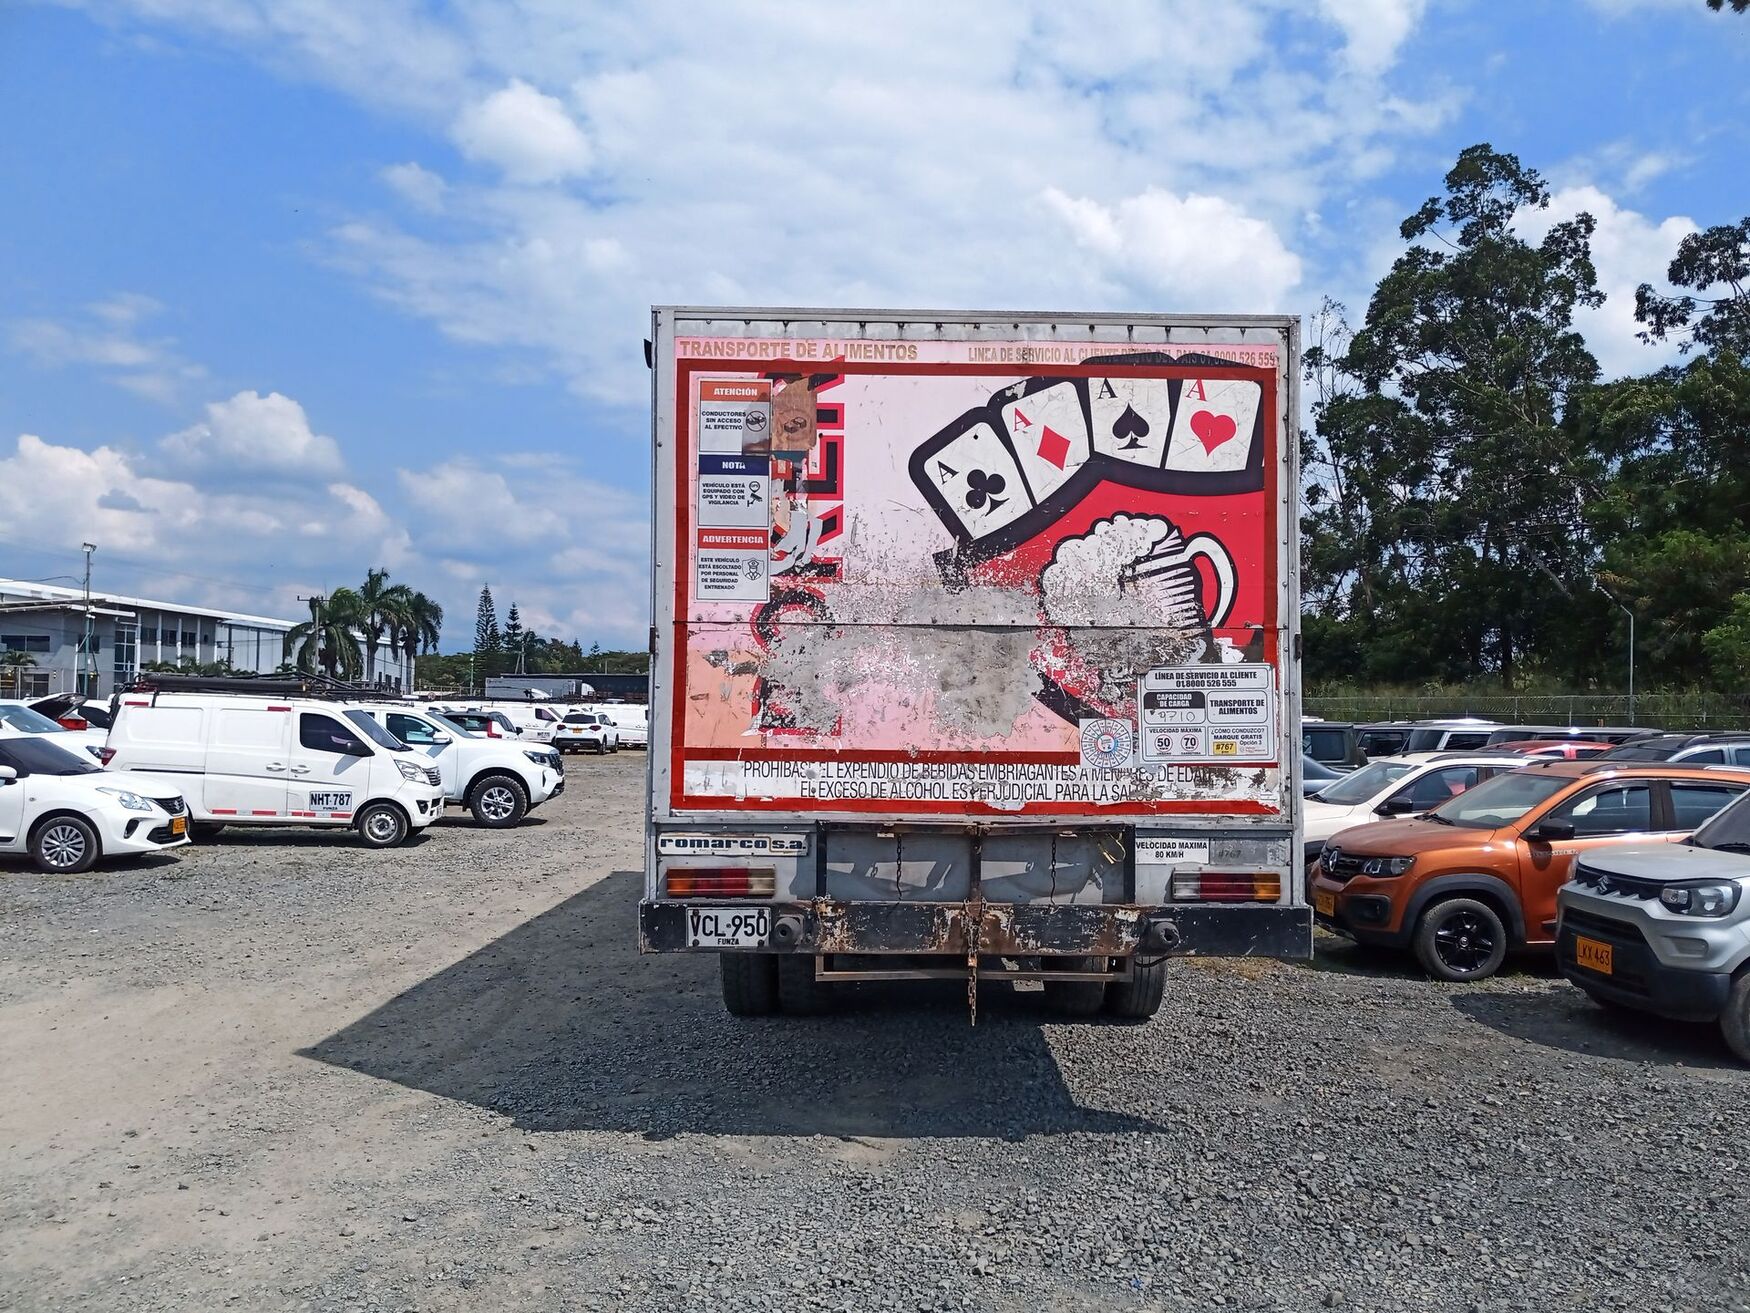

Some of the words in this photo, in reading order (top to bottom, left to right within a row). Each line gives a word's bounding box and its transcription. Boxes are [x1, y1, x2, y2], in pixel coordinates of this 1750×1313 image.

[680, 341, 790, 357] TRANSPORTE
[796, 343, 817, 358] DE
[822, 344, 918, 361] ALIMENTOS
[968, 348, 997, 361] LINEA
[1000, 348, 1013, 361] DE
[1016, 348, 1061, 362] SERVICIO
[1064, 349, 1076, 362] AL
[1239, 352, 1255, 366] 526
[714, 387, 758, 396] ATENCIÓN
[1097, 378, 1118, 399] A
[1186, 378, 1208, 402] A
[1013, 407, 1033, 432] A
[722, 461, 746, 470] NOTA
[938, 460, 959, 485] A
[703, 535, 764, 544] ADVERTENCIA
[1154, 671, 1174, 680] LÍNEA
[1176, 672, 1185, 680] DE
[1229, 671, 1257, 679] CLIENTE
[1222, 679, 1237, 687] 555
[1219, 707, 1258, 715] ALIMENTOS
[1157, 737, 1171, 748] 50
[1184, 737, 1196, 747] 70
[1215, 743, 1234, 751] #767
[744, 762, 812, 778] PROHIBAS
[837, 763, 899, 779] EXPENDIO
[903, 763, 918, 779] DE
[922, 764, 976, 780] BEBIDAS
[979, 764, 1076, 781] EMBRIAGANTES
[1079, 767, 1089, 781] A
[1158, 766, 1174, 782] DE
[801, 781, 815, 798] EL
[819, 781, 867, 799] EXCESO
[871, 782, 886, 799] DE
[890, 782, 949, 799] ALCOHOL
[952, 783, 967, 799] ES
[1056, 784, 1089, 801] PARA
[1093, 784, 1108, 801] LA
[660, 838, 767, 849] romarco
[772, 839, 806, 850] s.a.
